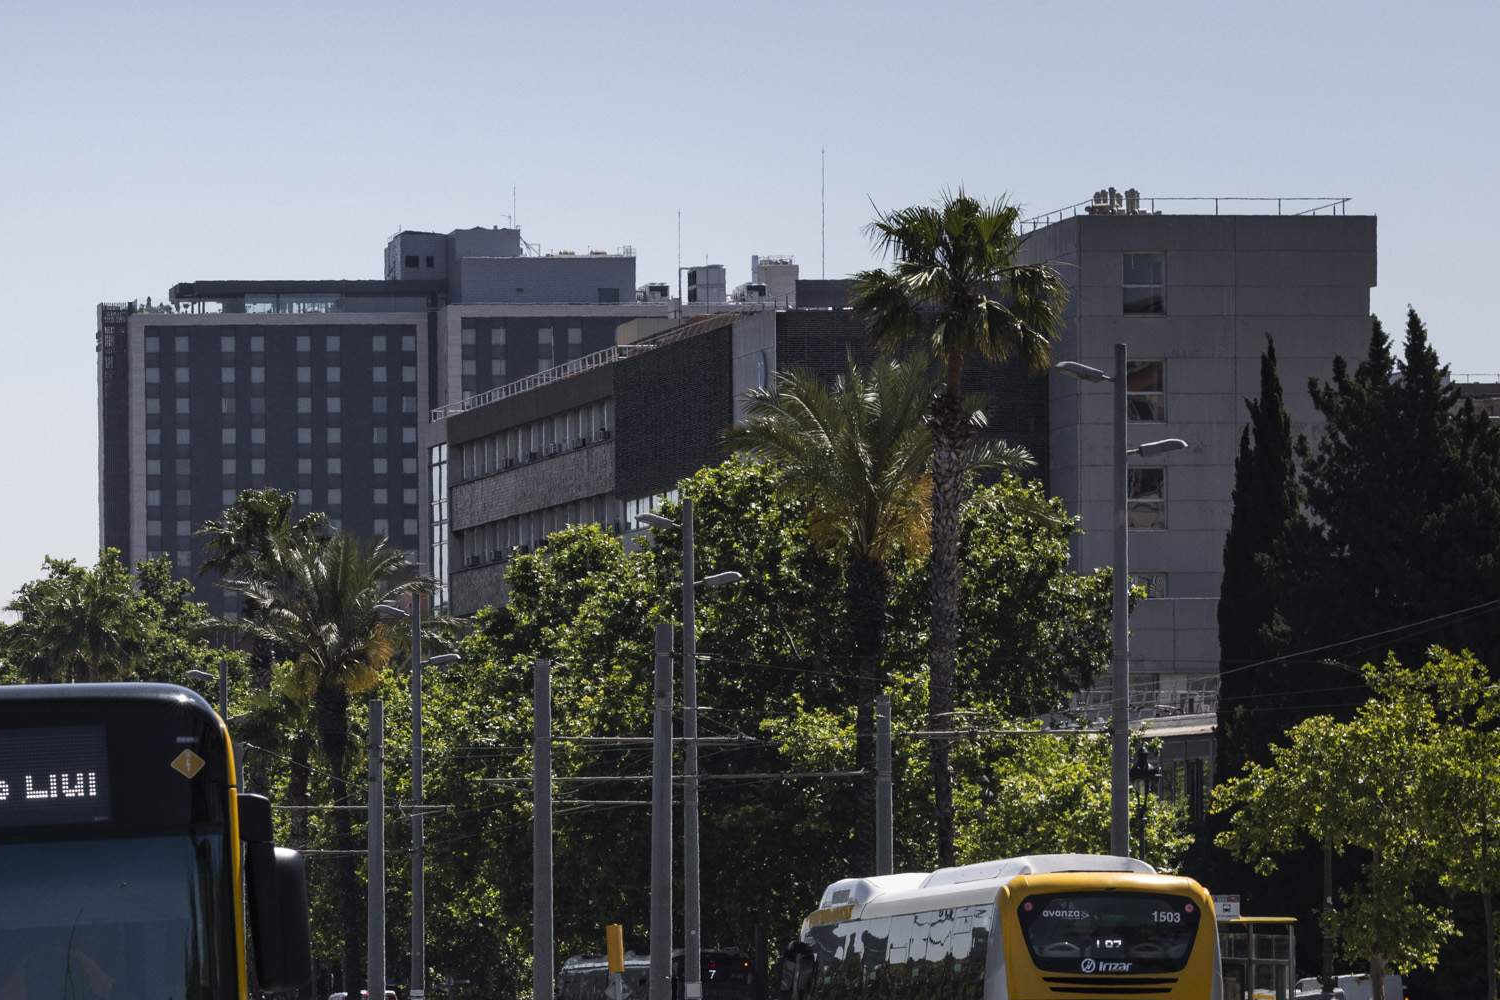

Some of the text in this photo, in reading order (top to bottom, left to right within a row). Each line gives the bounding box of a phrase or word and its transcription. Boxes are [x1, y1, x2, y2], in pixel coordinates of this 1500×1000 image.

[1042, 909, 1080, 919] avanza
[1152, 911, 1181, 923] 1503
[708, 969, 717, 980] 7
